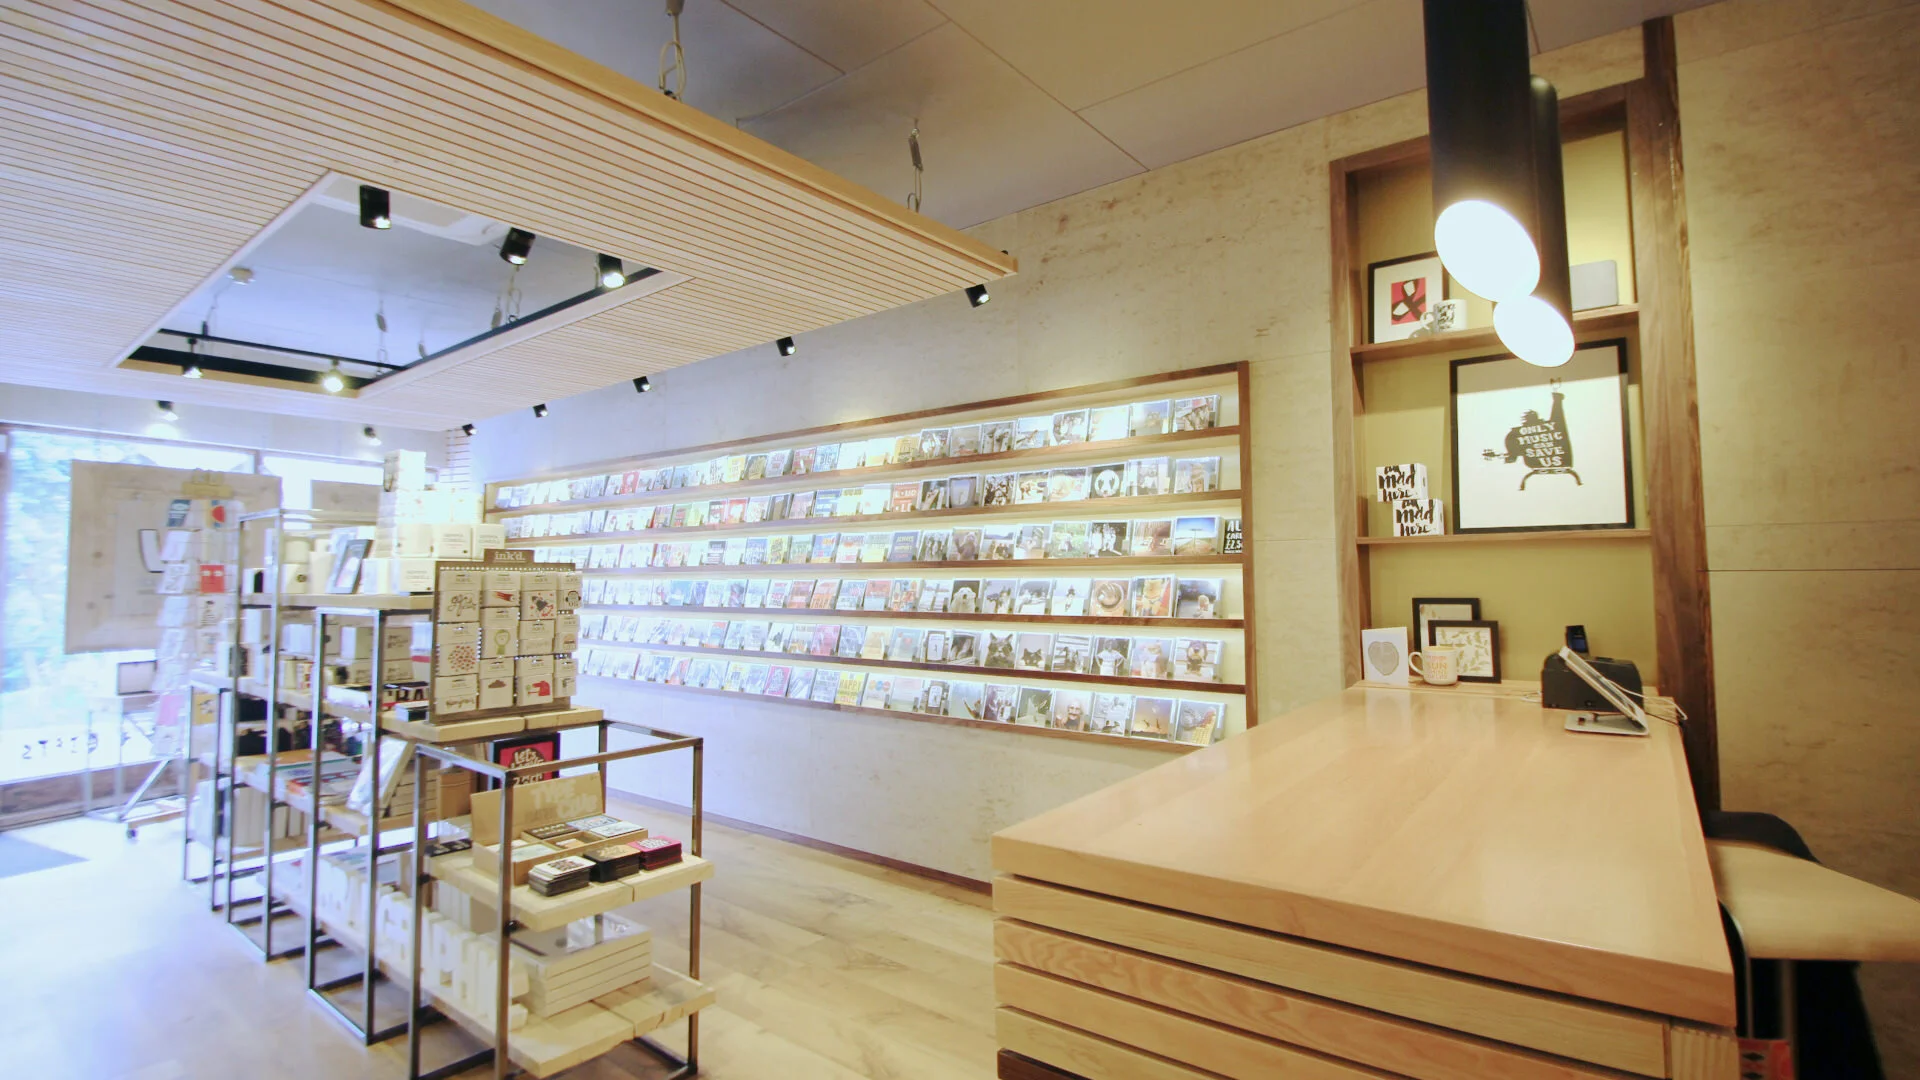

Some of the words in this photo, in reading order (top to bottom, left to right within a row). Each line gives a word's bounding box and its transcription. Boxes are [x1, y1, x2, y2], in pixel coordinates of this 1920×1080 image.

[1519, 422, 1556, 435] ONLY
[1517, 432, 1563, 445] MUSIC
[1525, 447, 1565, 458] SAVE
[1539, 456, 1562, 467] US
